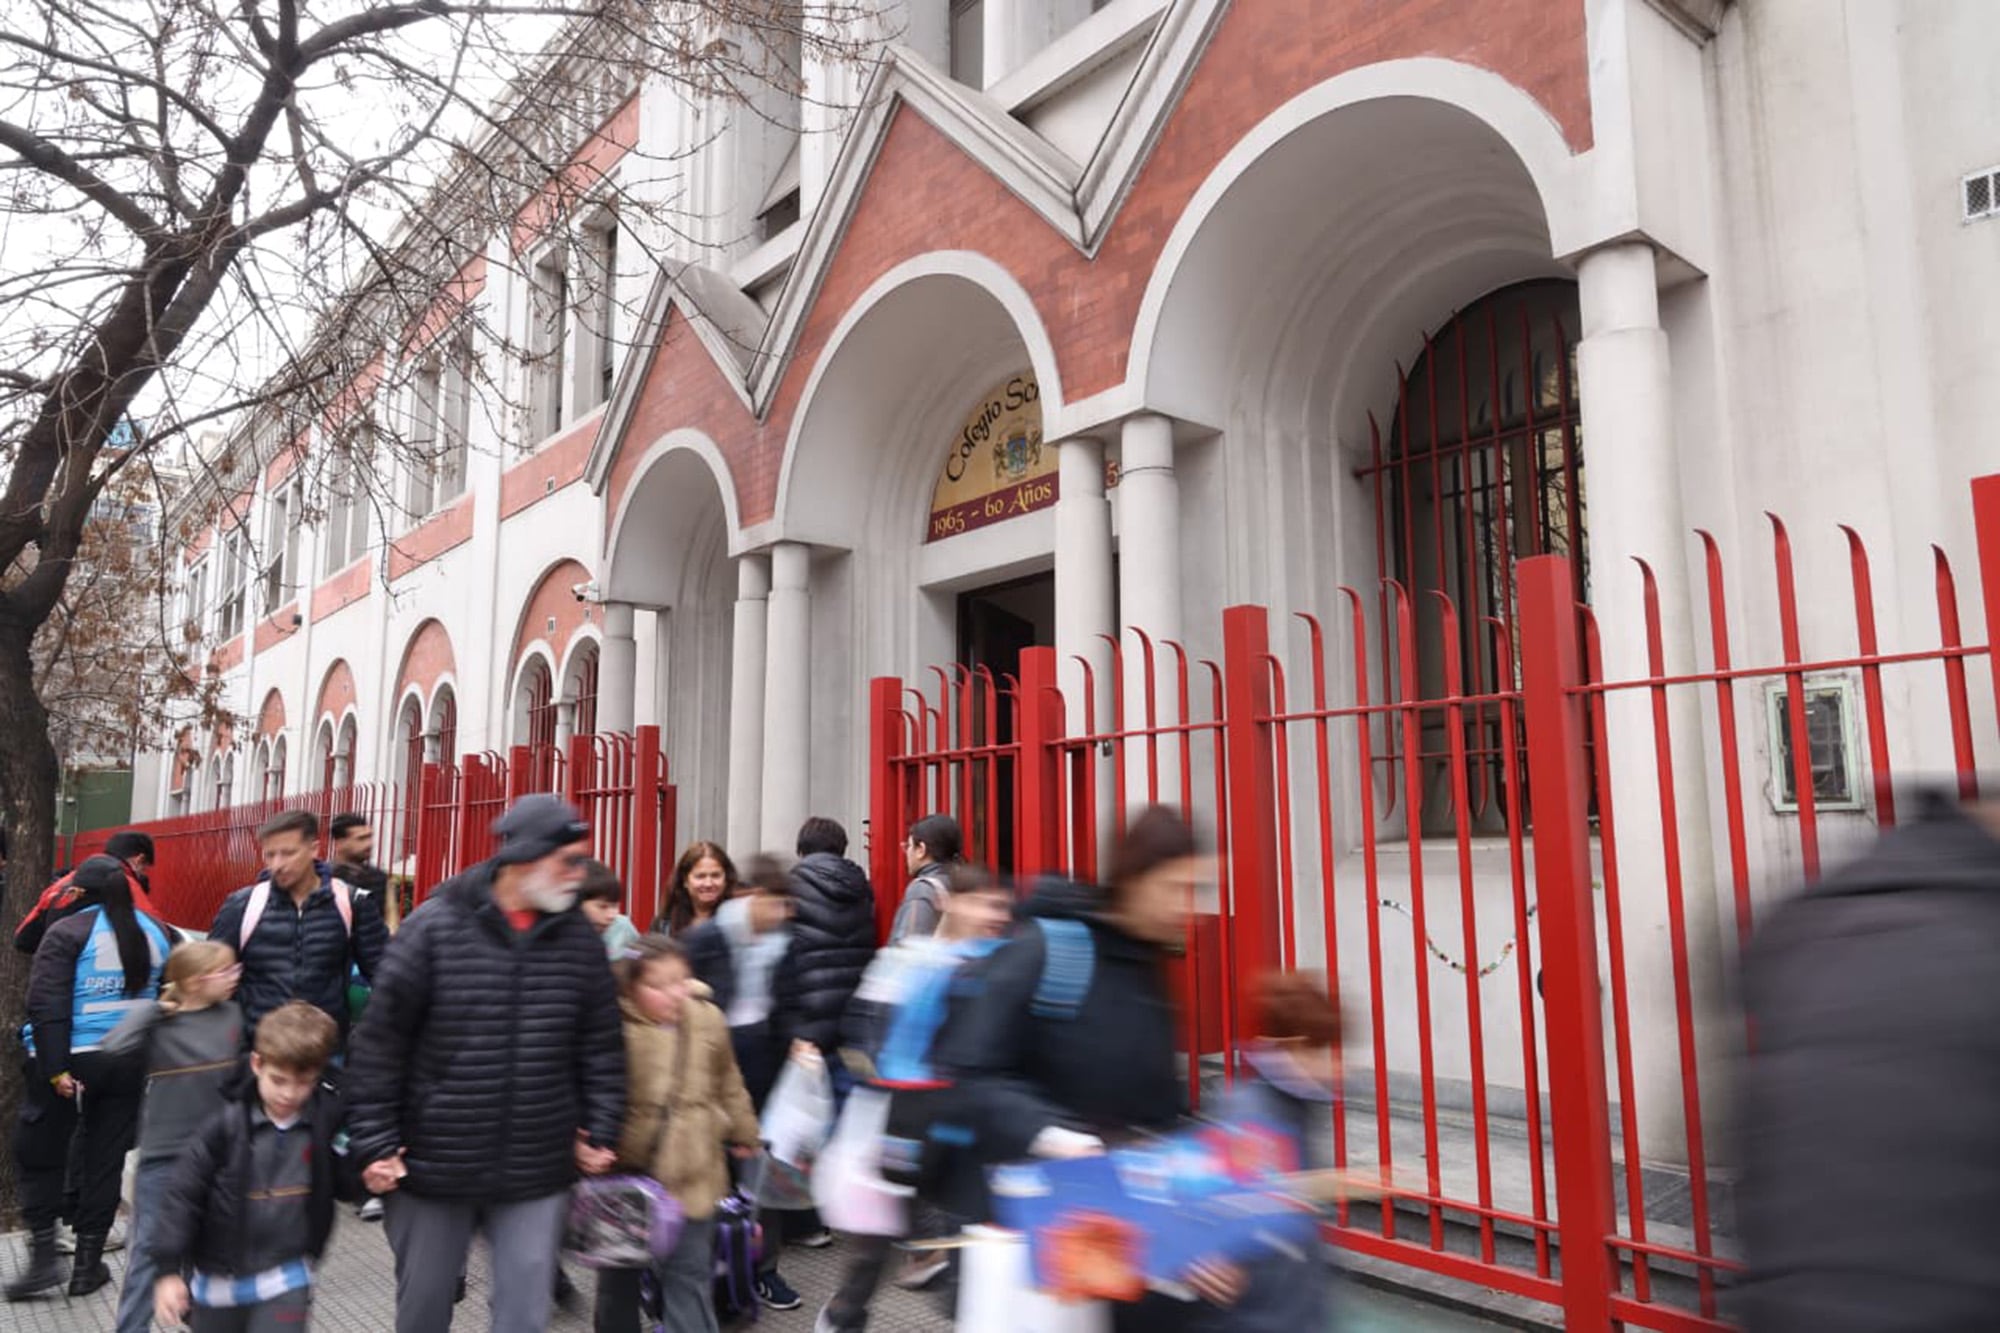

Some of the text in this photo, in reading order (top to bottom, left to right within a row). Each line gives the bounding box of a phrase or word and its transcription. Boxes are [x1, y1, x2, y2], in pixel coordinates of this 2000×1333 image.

[945, 402, 1002, 481] Colegio
[934, 509, 965, 537] 1965
[984, 496, 1004, 517] 60
[1008, 482, 1052, 512] Años
